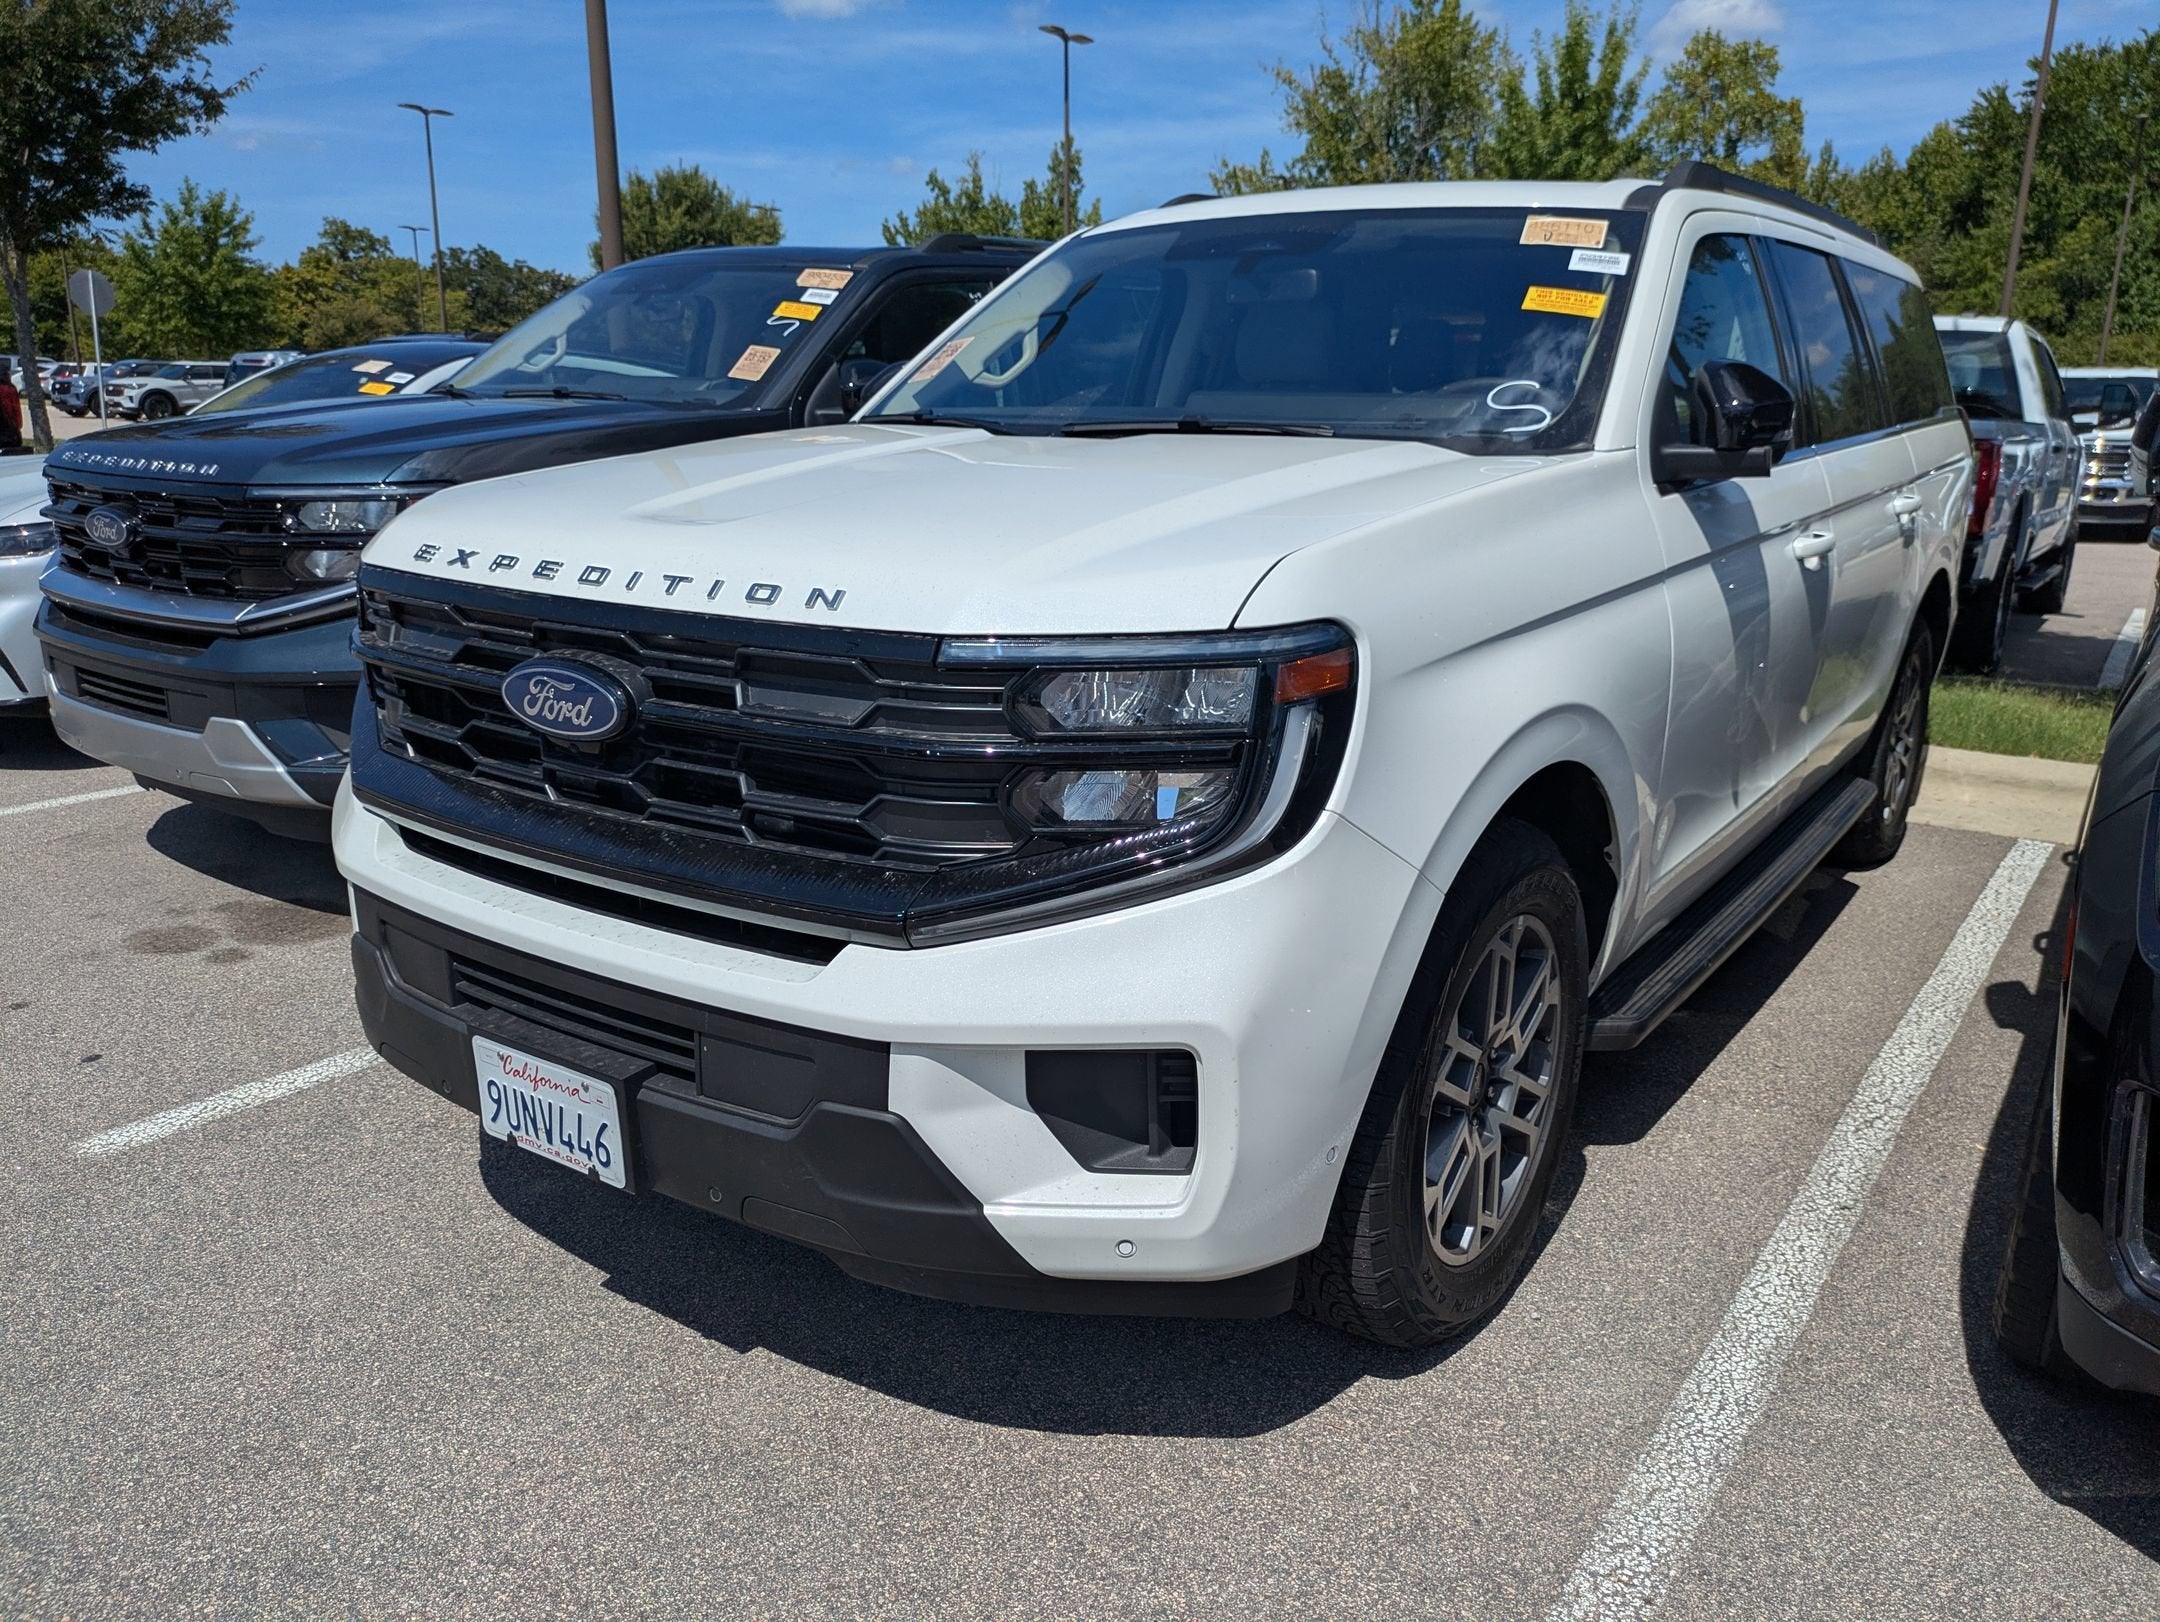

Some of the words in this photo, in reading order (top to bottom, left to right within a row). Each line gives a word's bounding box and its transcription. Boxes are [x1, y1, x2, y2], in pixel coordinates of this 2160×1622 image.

[92, 514, 118, 541] Ford
[413, 543, 847, 612] EXPEDITION
[523, 675, 594, 727] Ford
[502, 1054, 592, 1105] California
[486, 1078, 612, 1169] 9UNV446
[516, 1134, 590, 1169] dmv.ca.gov
